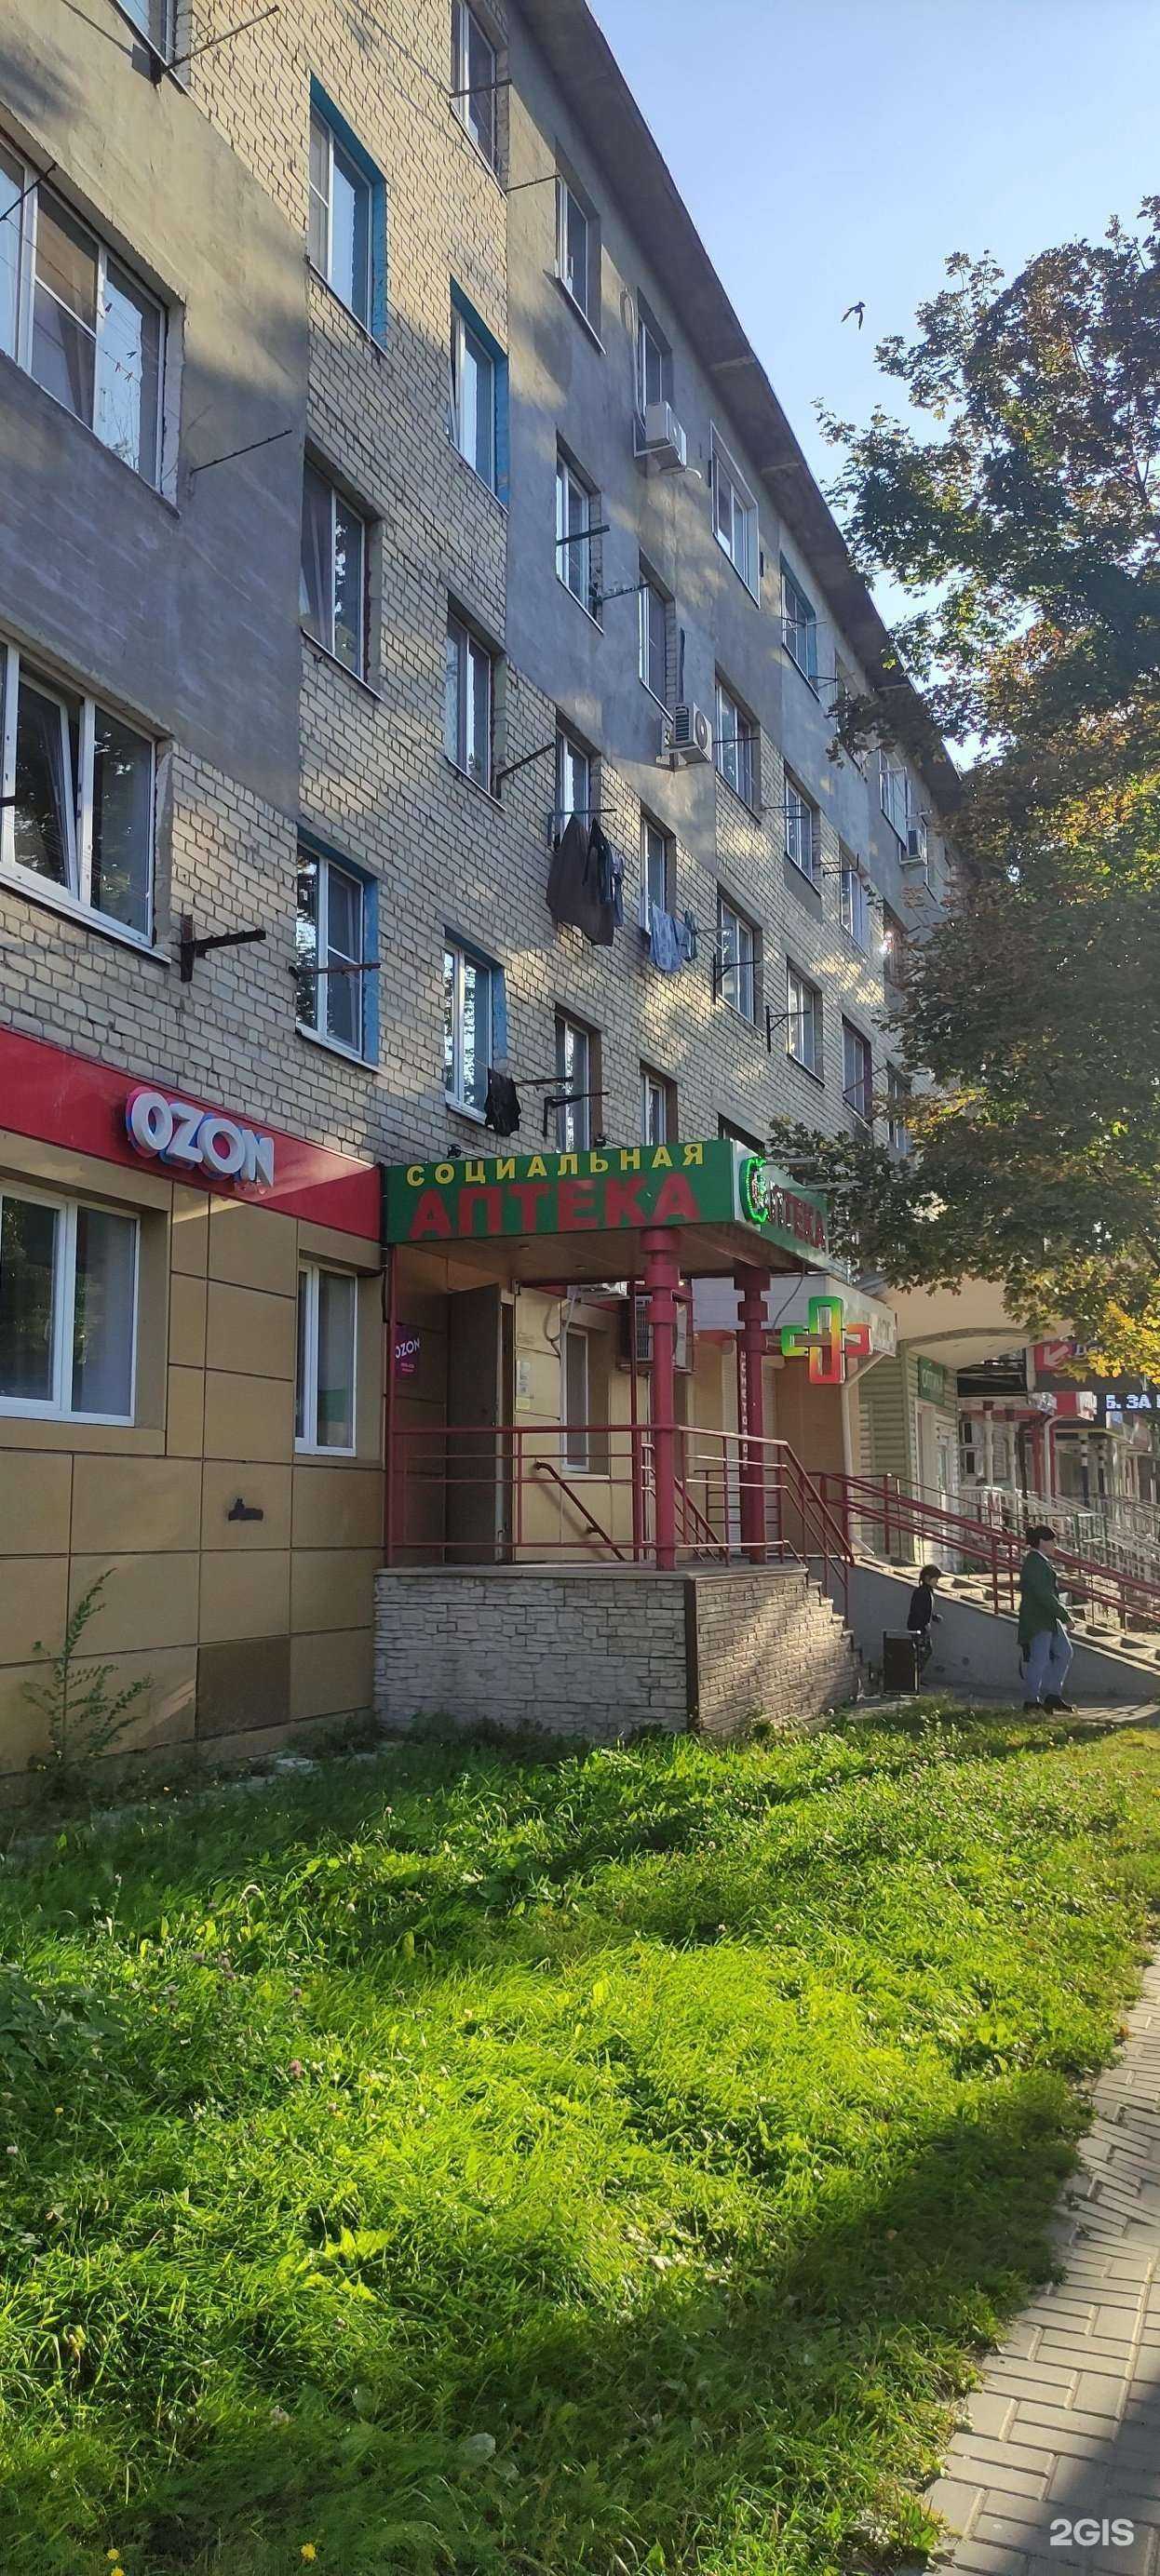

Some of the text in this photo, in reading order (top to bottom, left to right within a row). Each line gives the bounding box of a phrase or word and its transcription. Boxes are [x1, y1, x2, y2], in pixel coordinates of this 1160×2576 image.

[128, 1089, 275, 1187] OZON
[407, 1143, 704, 1187] СОЦИАЛЬНАЯ
[408, 1172, 699, 1240] АПТЕКА
[395, 1337, 421, 1359] OZON
